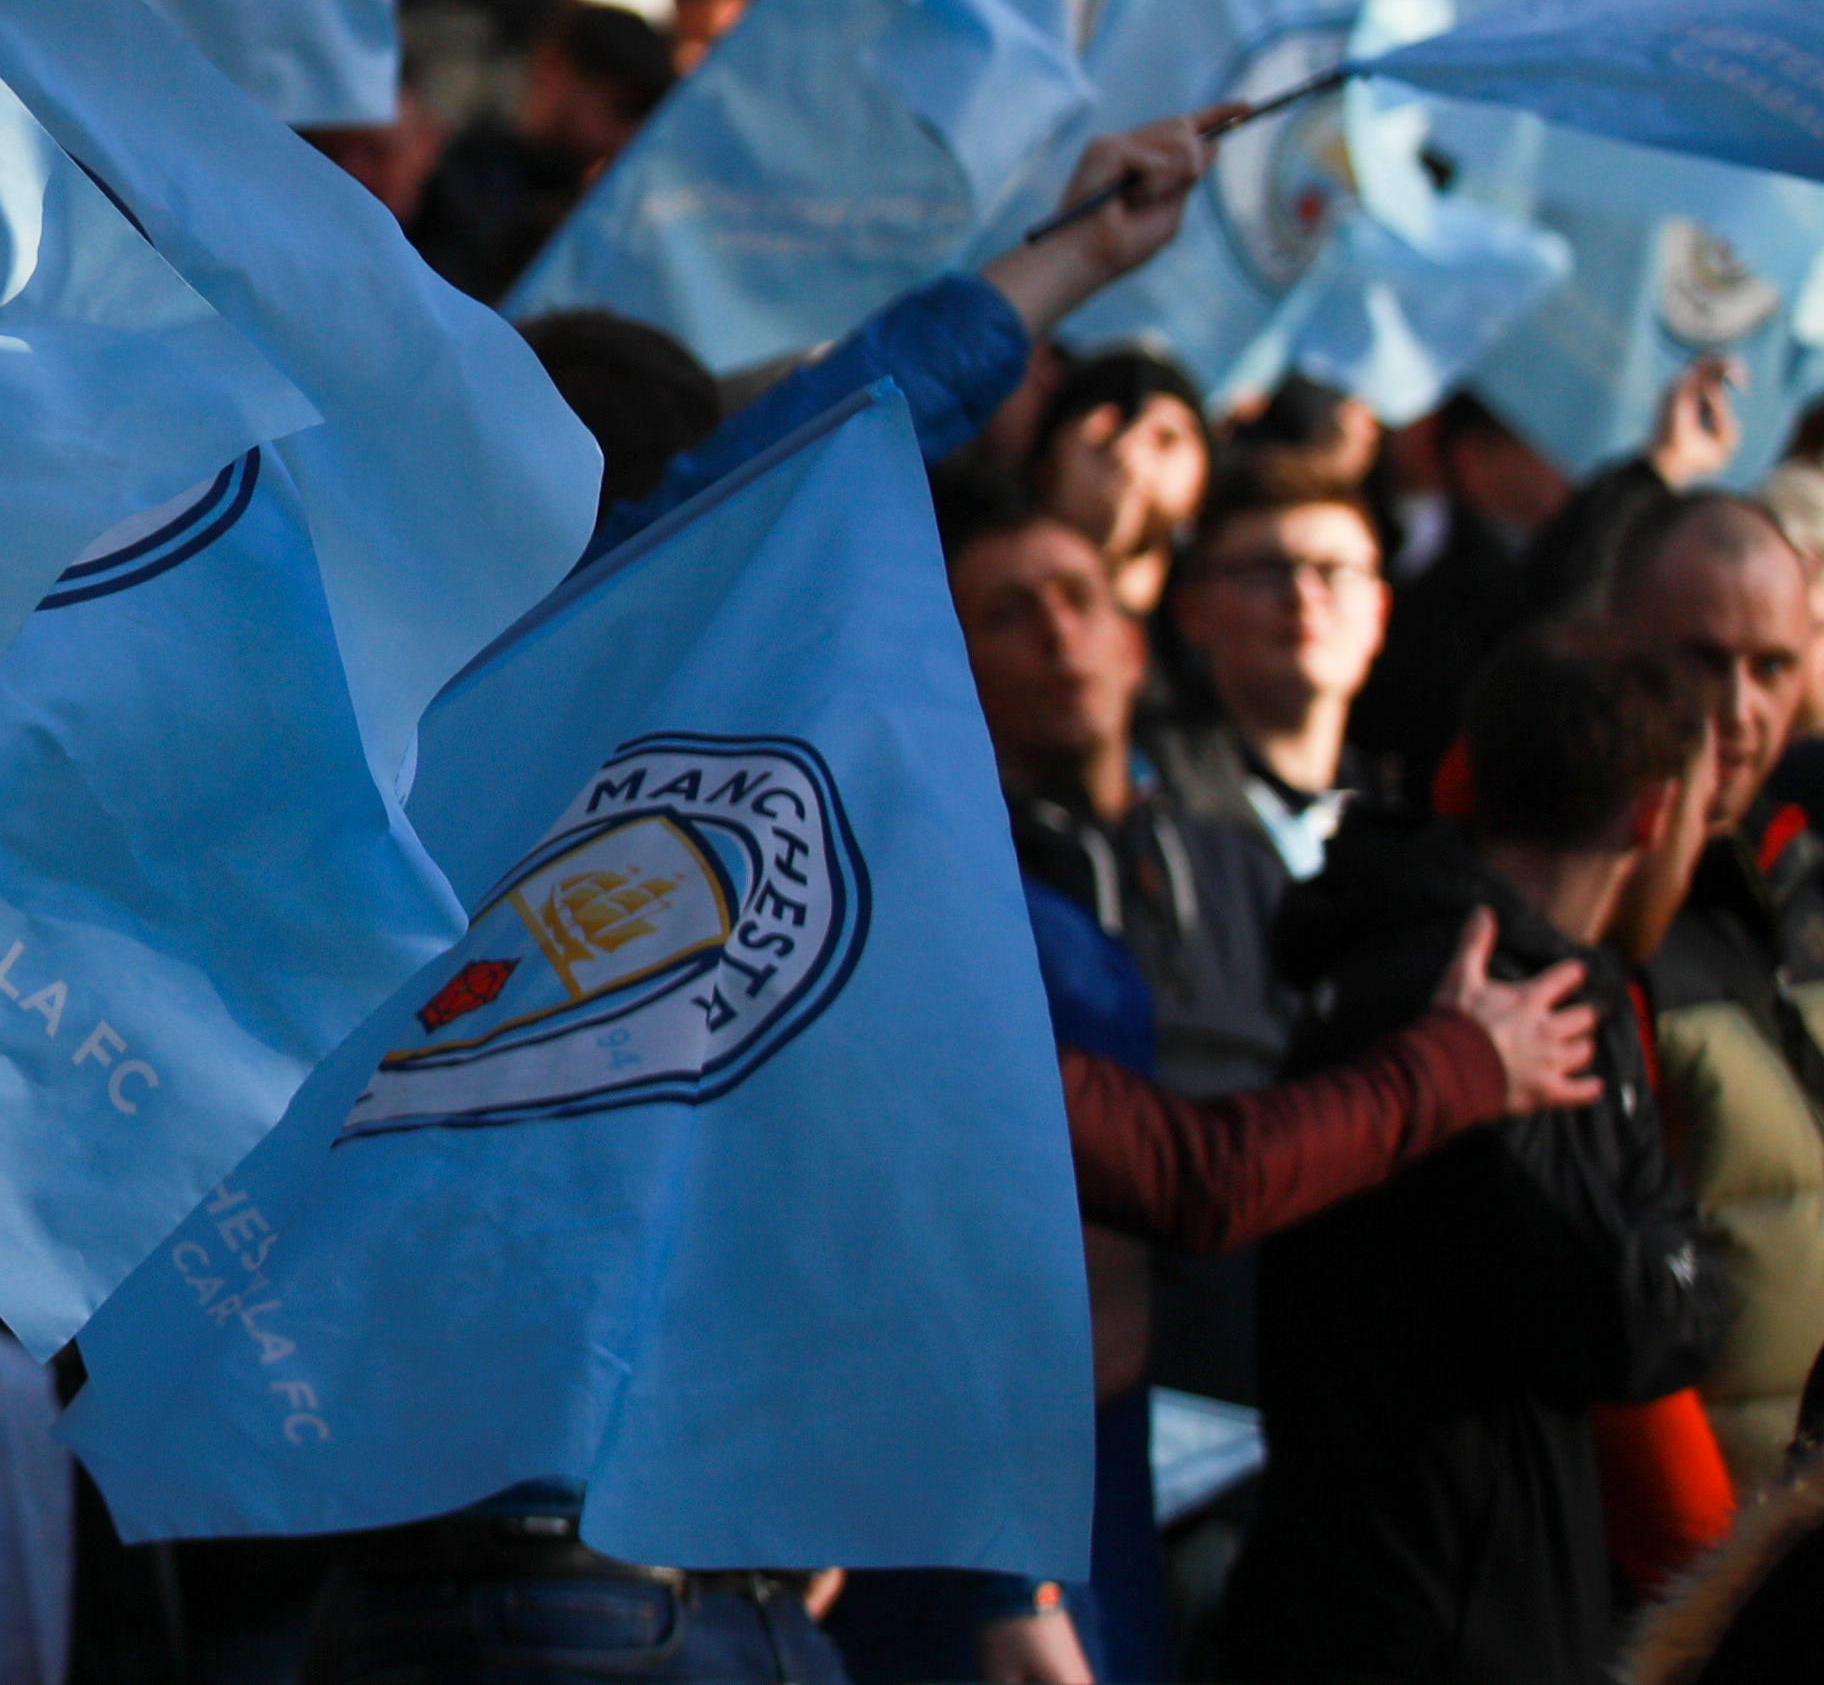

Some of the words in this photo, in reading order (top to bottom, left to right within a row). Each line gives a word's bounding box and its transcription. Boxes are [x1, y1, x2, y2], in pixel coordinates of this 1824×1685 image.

[585, 767, 810, 1033] MANCHESTR
[70, 1019, 160, 1115] FC
[596, 1027, 642, 1070] 94
[270, 1381, 331, 1445] FC
